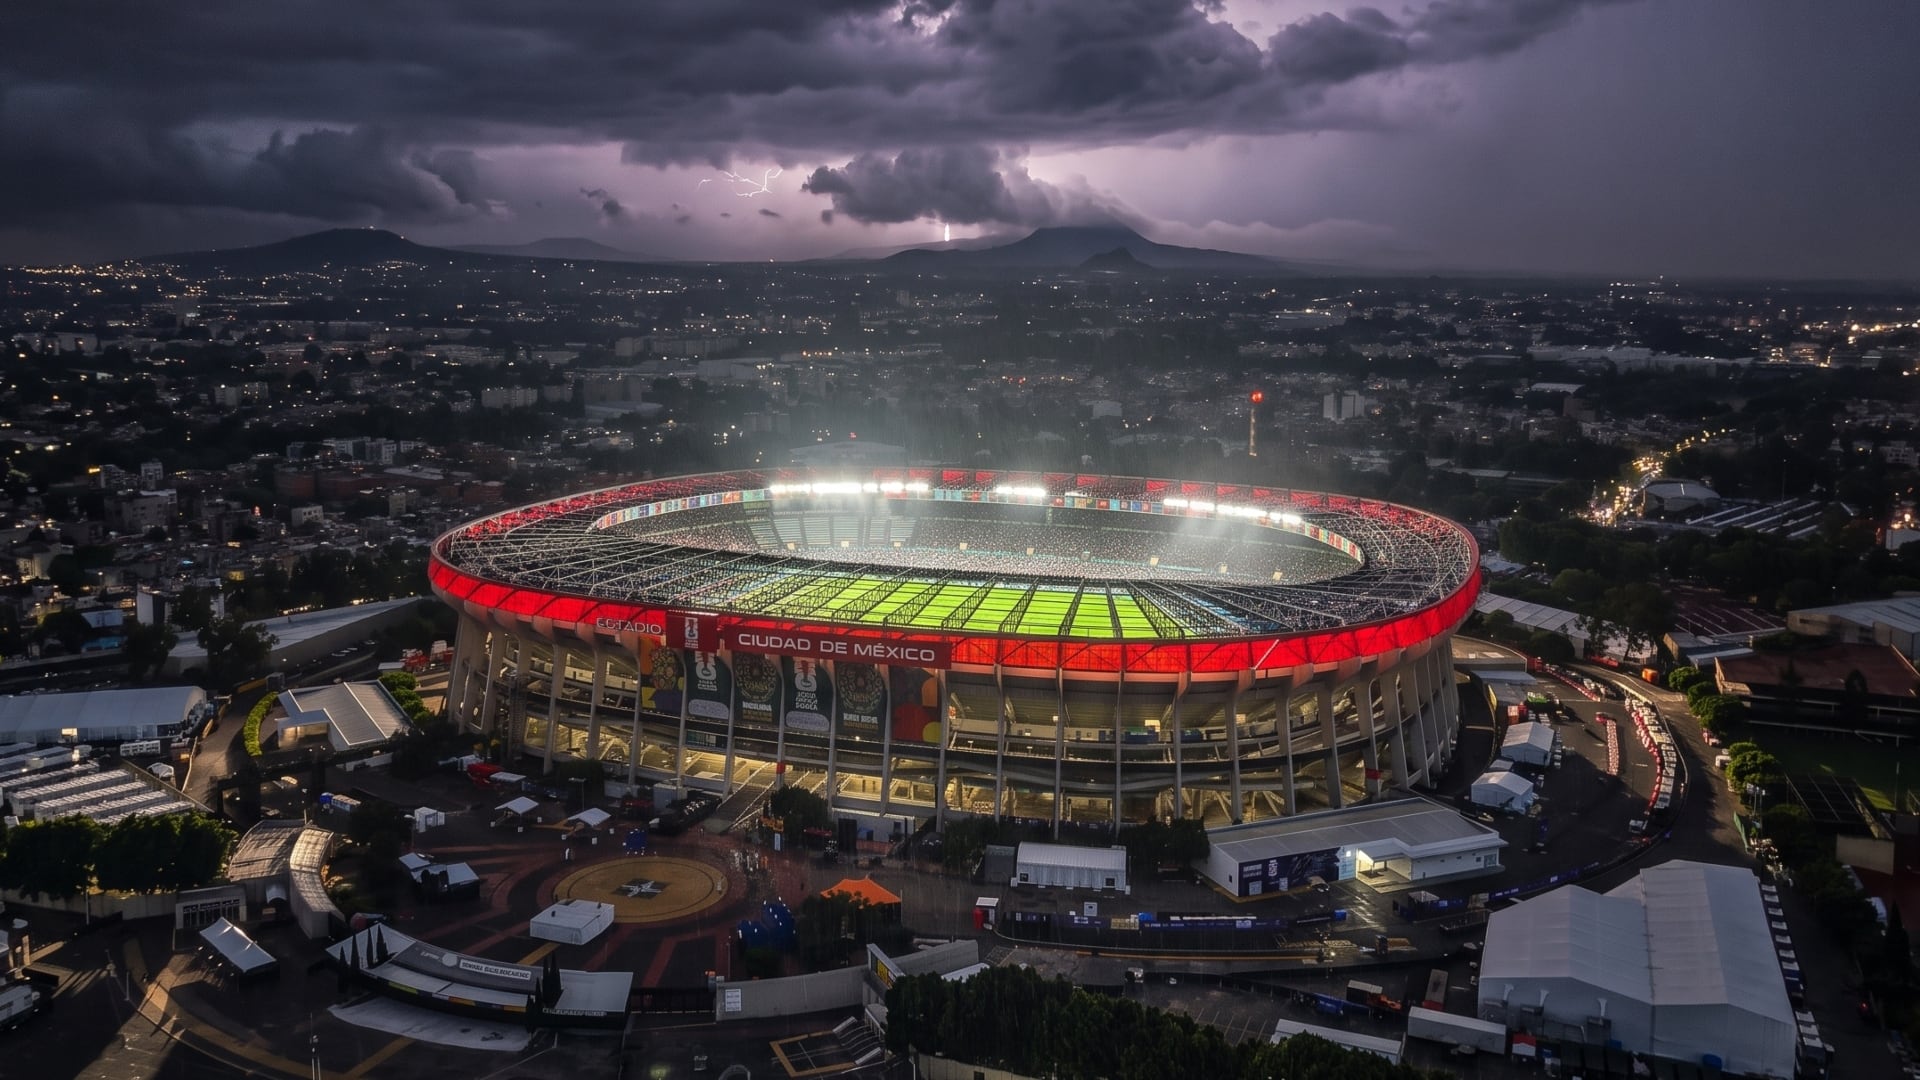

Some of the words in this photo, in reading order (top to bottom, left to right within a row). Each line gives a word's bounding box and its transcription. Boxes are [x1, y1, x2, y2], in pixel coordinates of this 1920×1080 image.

[738, 633, 811, 651] CIUDAD
[820, 640, 848, 654] DE
[854, 642, 935, 662] MÉXICO
